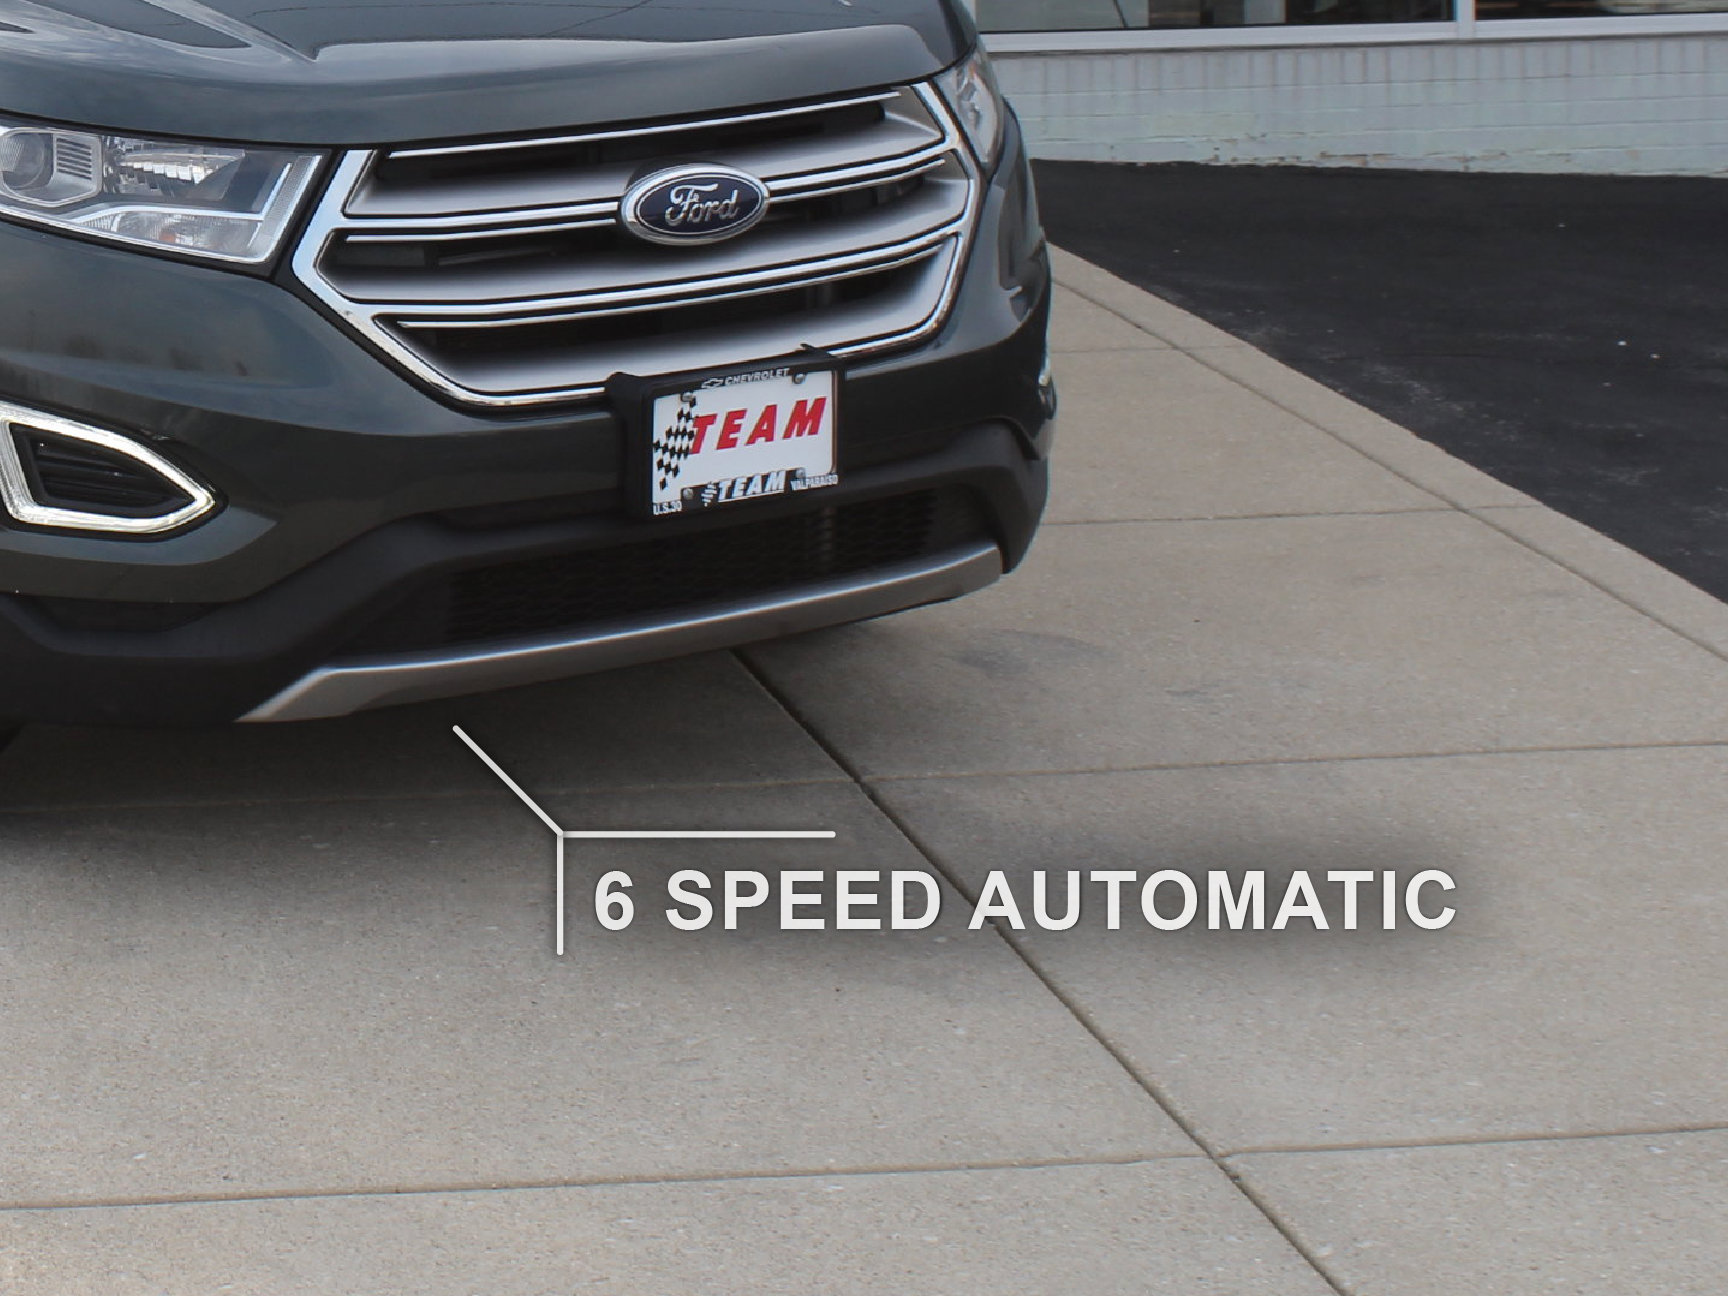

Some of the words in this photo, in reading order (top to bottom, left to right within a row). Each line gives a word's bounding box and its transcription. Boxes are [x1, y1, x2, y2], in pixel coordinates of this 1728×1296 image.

[664, 183, 740, 227] Ford
[724, 367, 791, 386] CHEVROLET
[688, 396, 827, 455] TEAM
[717, 470, 787, 503] TEAM
